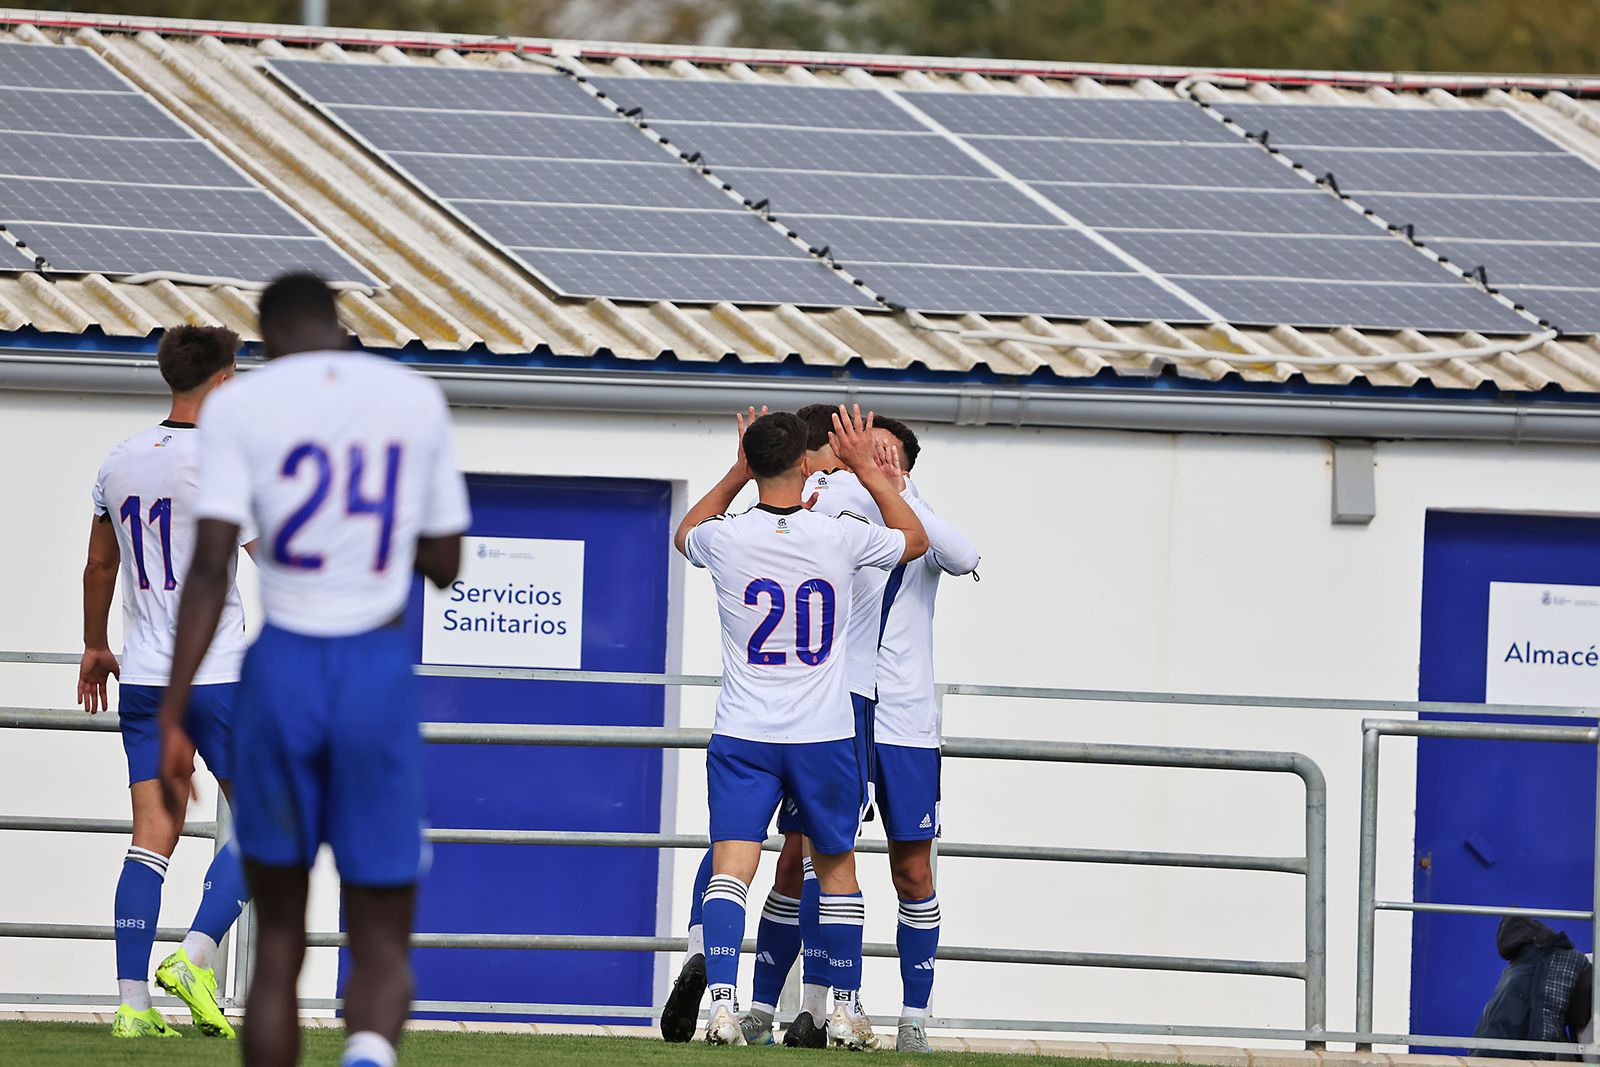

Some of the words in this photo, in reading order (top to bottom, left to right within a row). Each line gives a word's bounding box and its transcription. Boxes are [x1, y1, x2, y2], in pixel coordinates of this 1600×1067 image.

[273, 440, 403, 572] 24
[119, 495, 178, 591] 11
[450, 580, 562, 606] Servicios
[443, 609, 567, 635] Sanitarios
[743, 578, 836, 667] 20
[1504, 640, 1599, 666] Almacé
[115, 918, 145, 930] 1889
[709, 946, 736, 957] 1889
[828, 957, 853, 968] 1889
[712, 988, 731, 1001] FS
